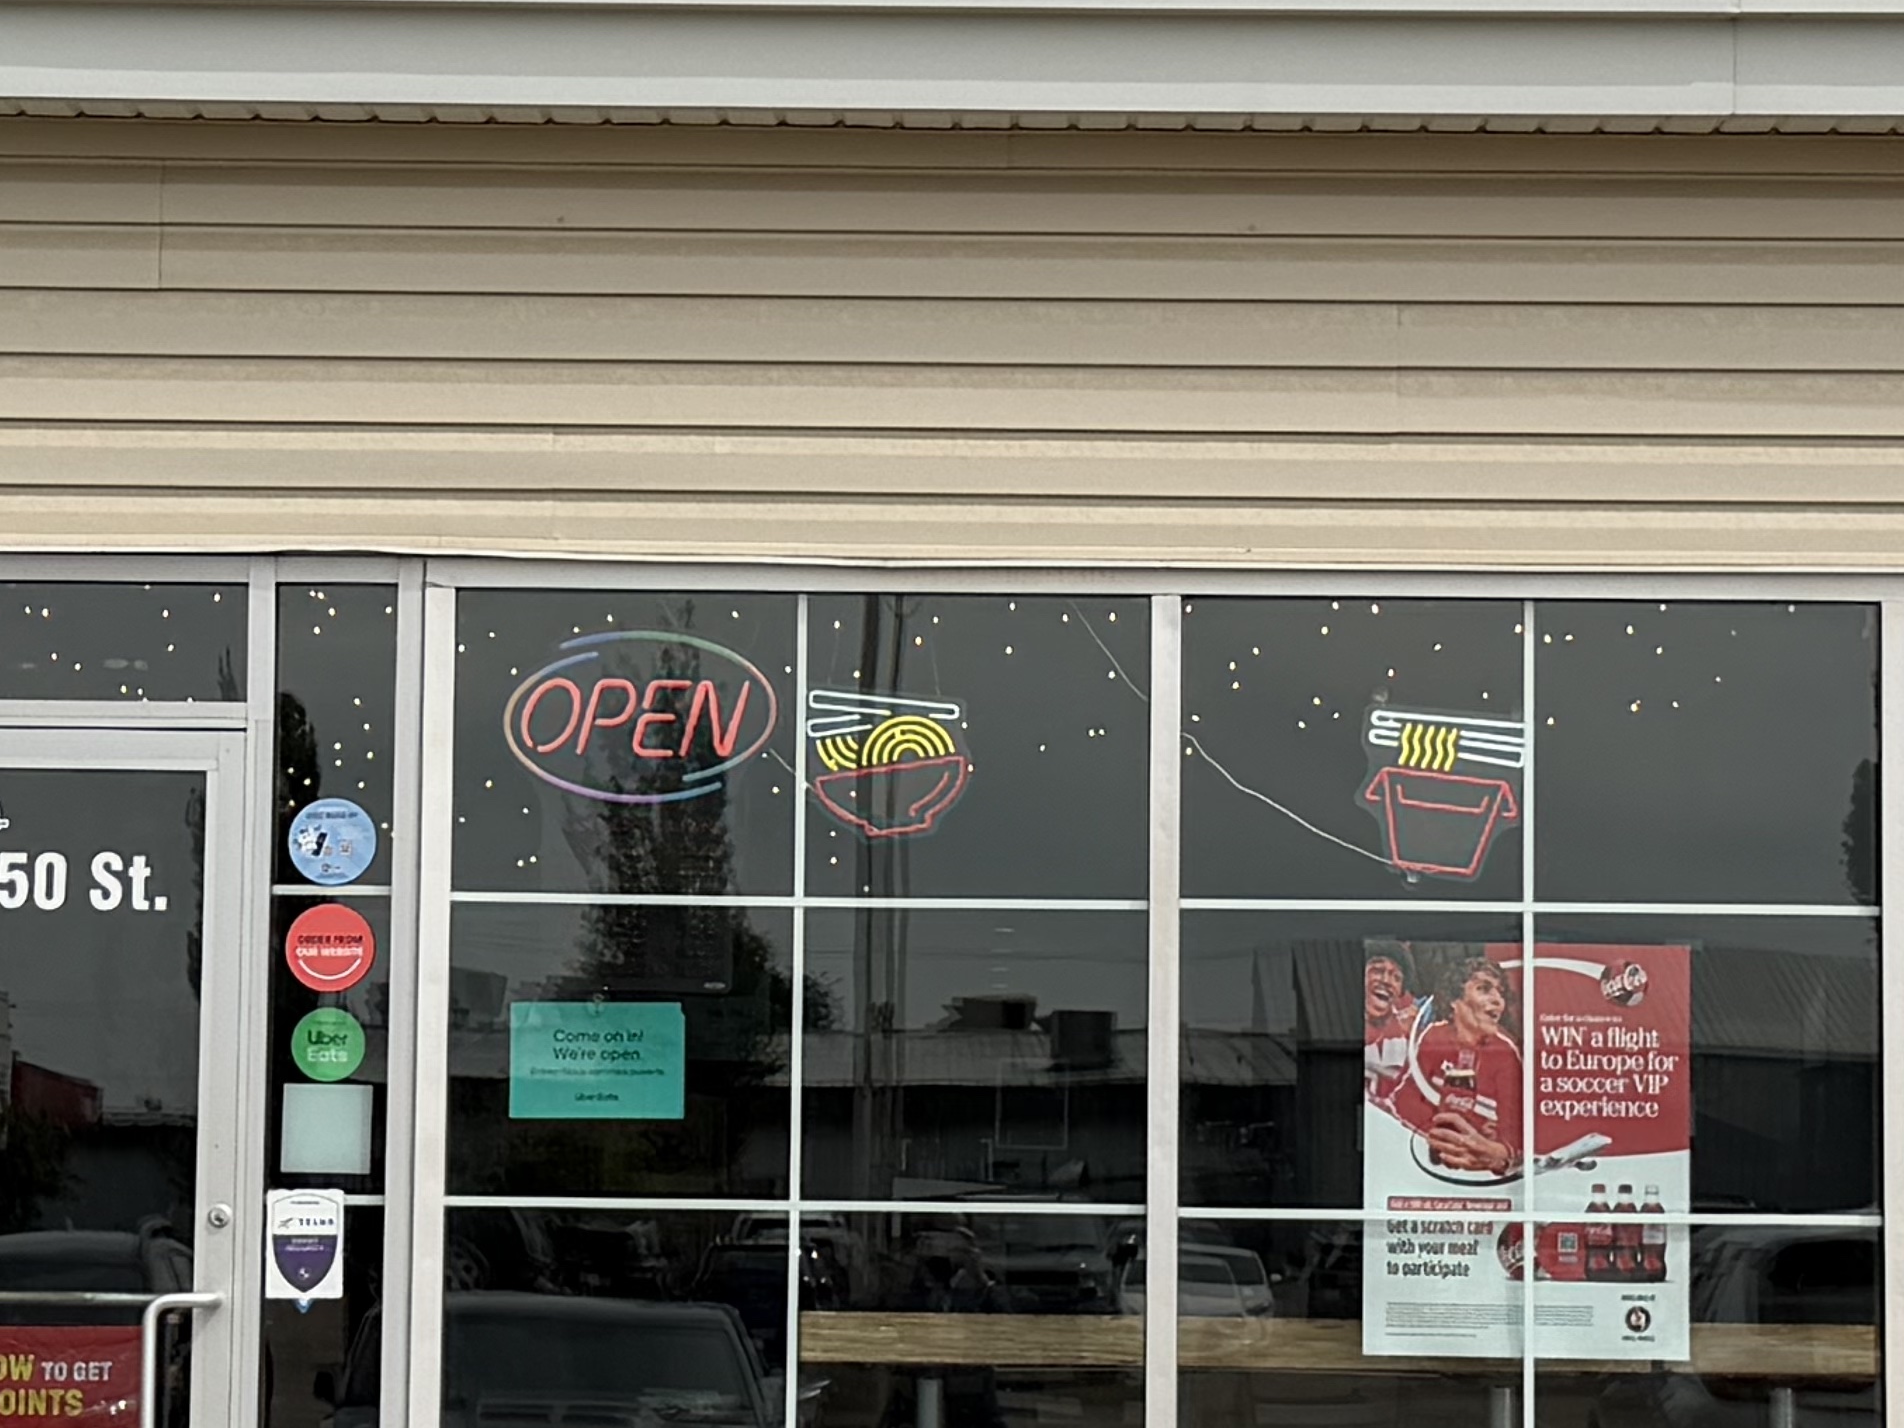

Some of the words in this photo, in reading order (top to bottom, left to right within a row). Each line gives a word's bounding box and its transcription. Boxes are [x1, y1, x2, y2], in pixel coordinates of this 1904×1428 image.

[522, 678, 748, 758] OPEN
[89, 852, 169, 912] St.
[307, 1030, 348, 1046] Uber
[553, 1029, 600, 1043] Come
[603, 1031, 624, 1043] on
[1590, 1033, 1604, 1047] a
[1607, 1026, 1660, 1052] flight
[306, 1049, 348, 1063] Eats
[1540, 1051, 1562, 1070] to
[1566, 1050, 1644, 1075] Europe
[1647, 1051, 1679, 1071] for
[1540, 1078, 1553, 1093] a
[1556, 1077, 1629, 1093] soccer
[1632, 1074, 1670, 1094] VIP
[1540, 1097, 1659, 1121] experience
[1387, 1238, 1415, 1254] with
[1418, 1242, 1445, 1258] your
[1387, 1260, 1399, 1275] to
[1402, 1259, 1471, 1279] participate
[41, 1361, 68, 1381] TO
[73, 1361, 113, 1381] GET
